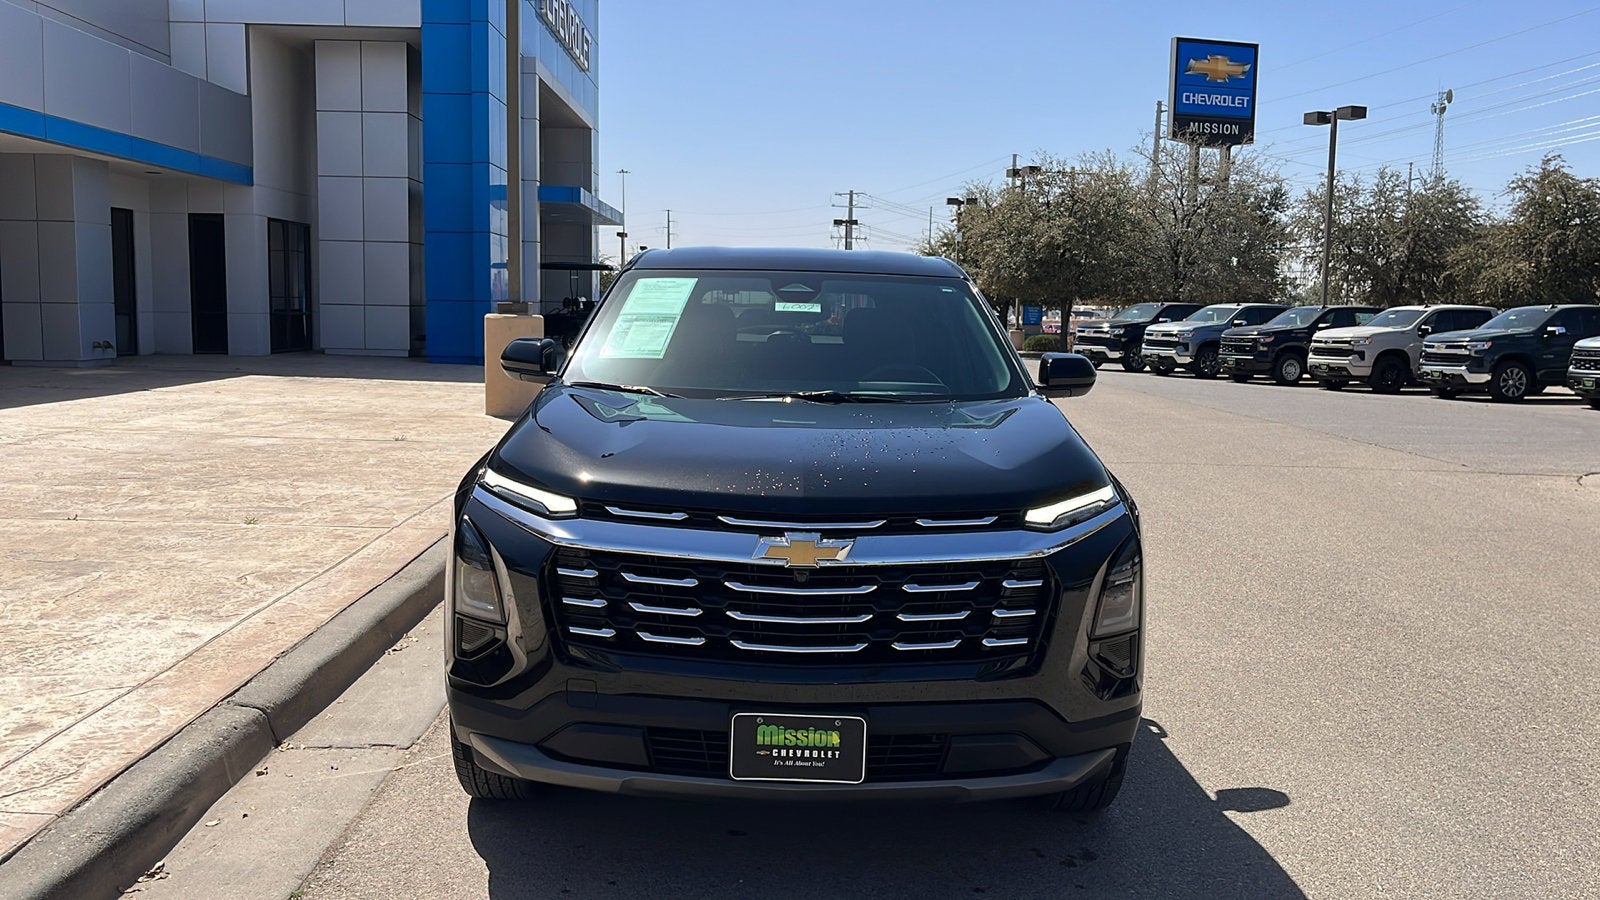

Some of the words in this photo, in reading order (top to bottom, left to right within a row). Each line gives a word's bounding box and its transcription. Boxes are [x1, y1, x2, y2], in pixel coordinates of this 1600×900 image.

[1182, 92, 1250, 108] CHEVROLET
[1189, 121, 1239, 135] MISSION
[757, 725, 840, 747] Mission
[772, 749, 840, 758] CHEVROLET
